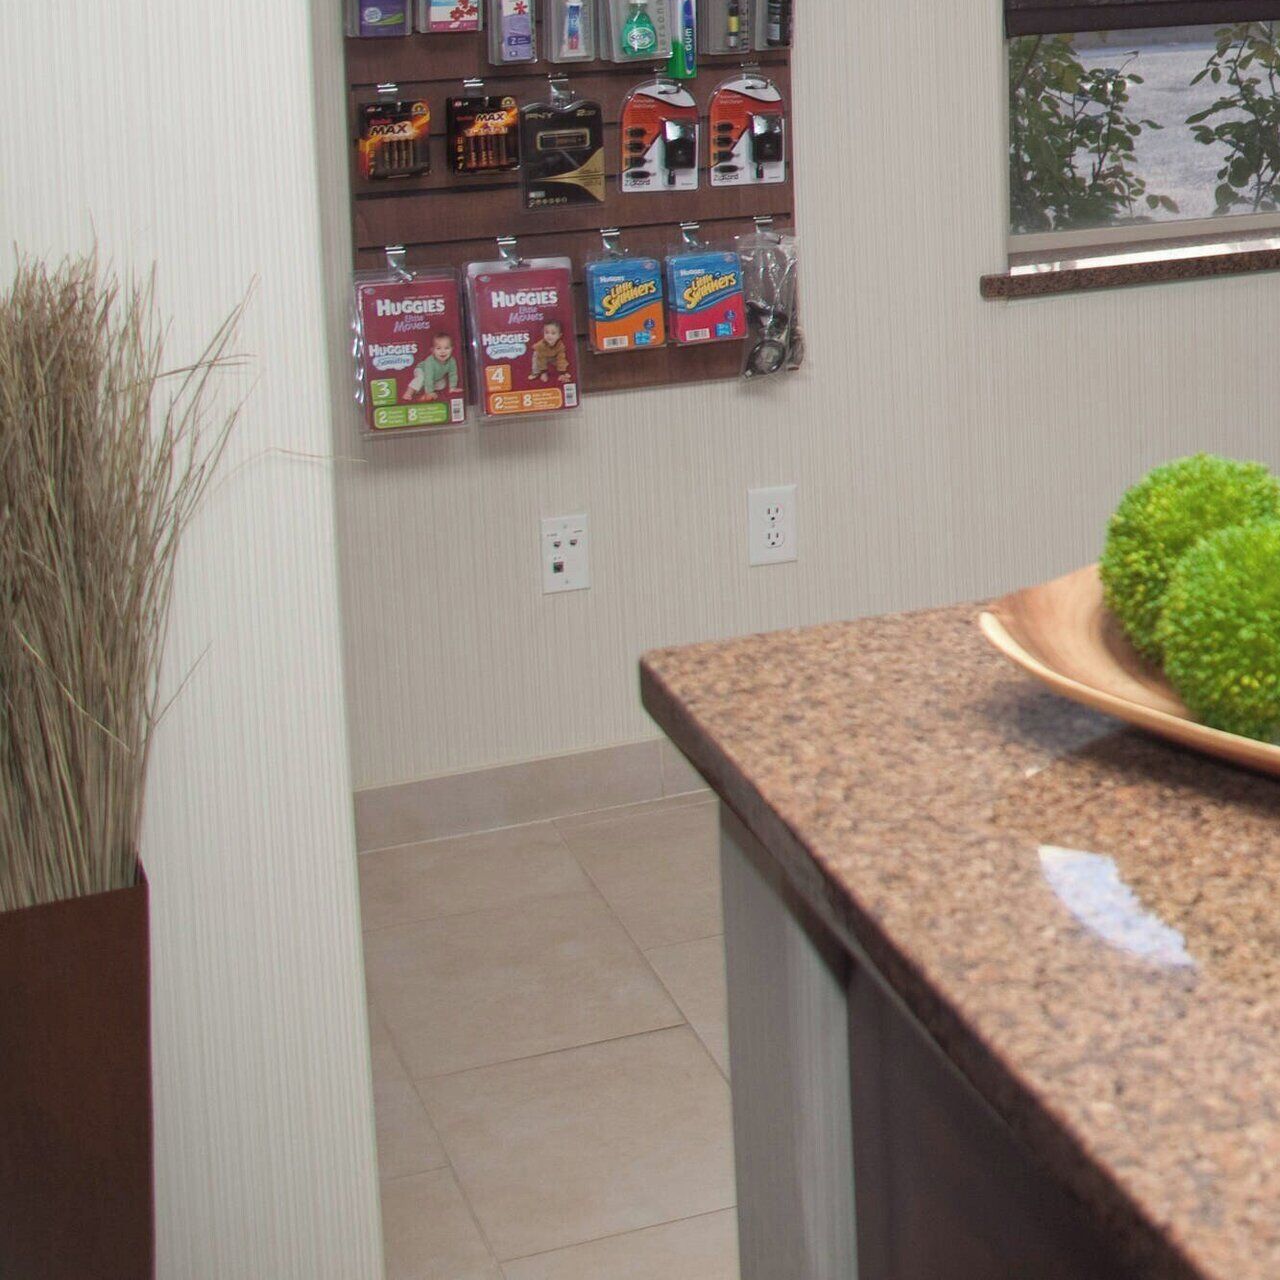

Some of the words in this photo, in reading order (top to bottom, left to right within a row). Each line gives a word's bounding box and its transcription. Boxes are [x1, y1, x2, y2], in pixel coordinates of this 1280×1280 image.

[491, 291, 558, 308] HUGGIES
[376, 299, 445, 316] HUGGIES
[482, 333, 530, 346] HUGGIES
[368, 344, 418, 357] HUGGIES
